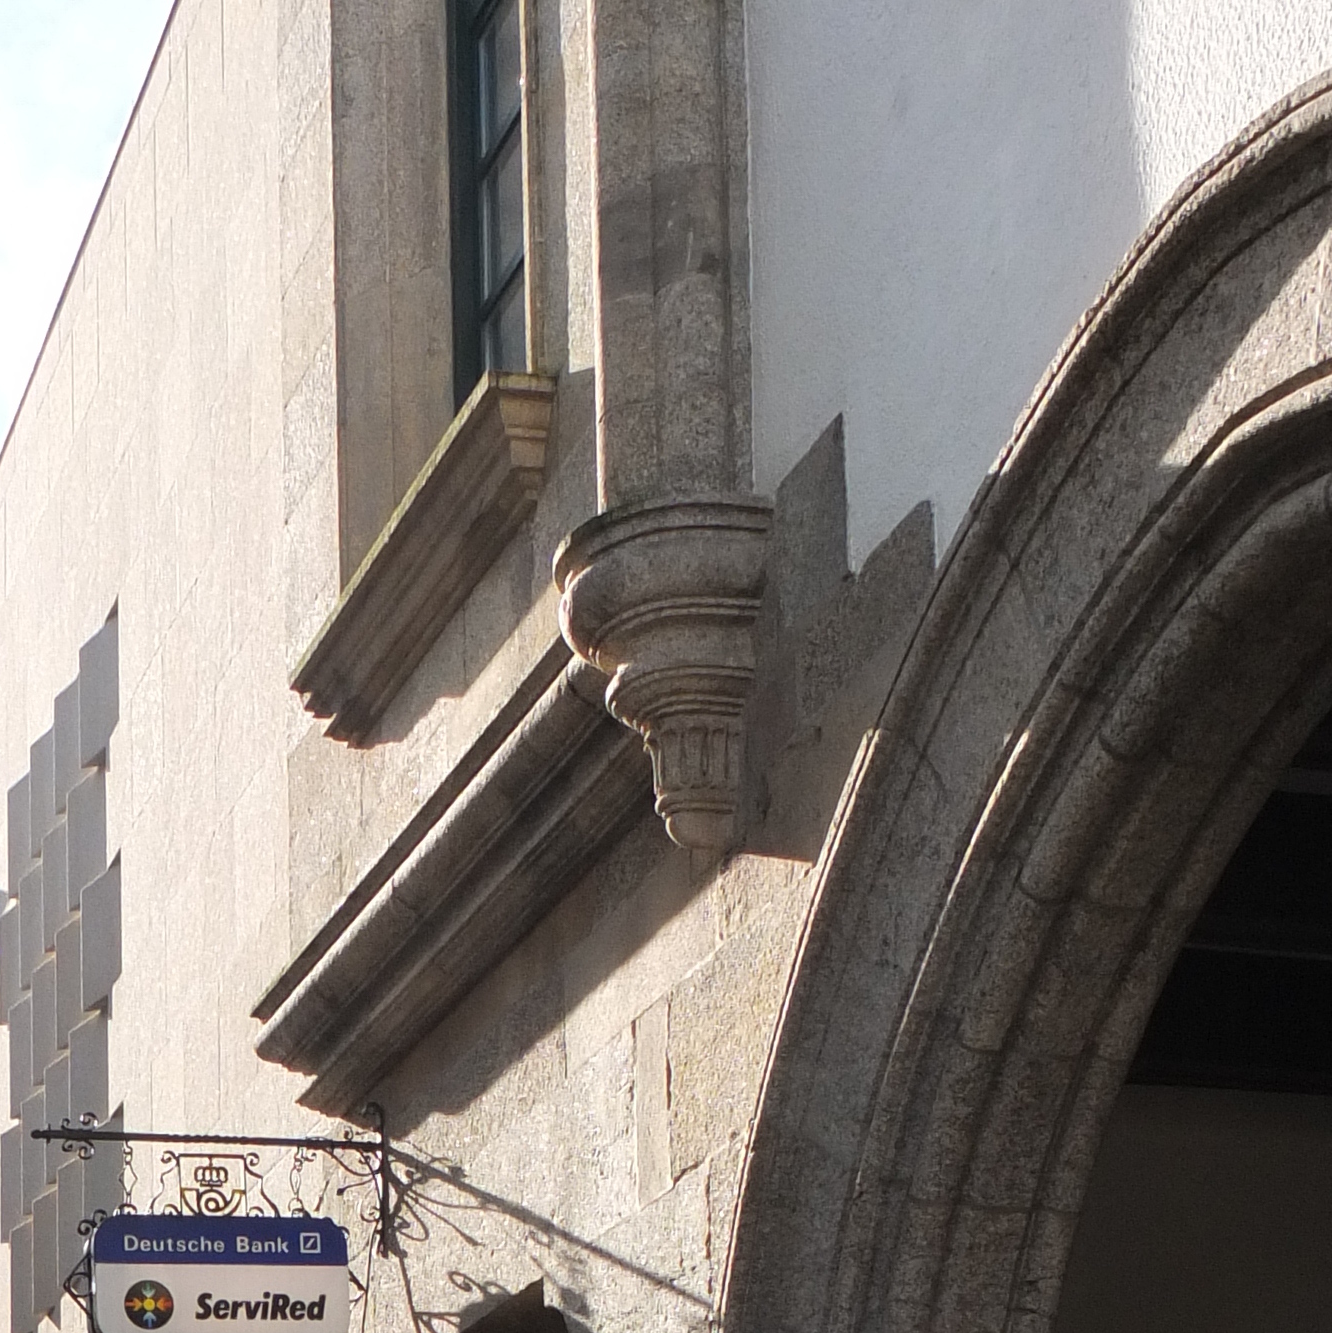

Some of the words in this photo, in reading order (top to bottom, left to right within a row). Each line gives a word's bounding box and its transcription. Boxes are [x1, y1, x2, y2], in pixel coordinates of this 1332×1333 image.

[123, 1234, 225, 1254] Deutsche
[235, 1235, 290, 1255] Bank
[194, 1291, 327, 1322] ServiRed
